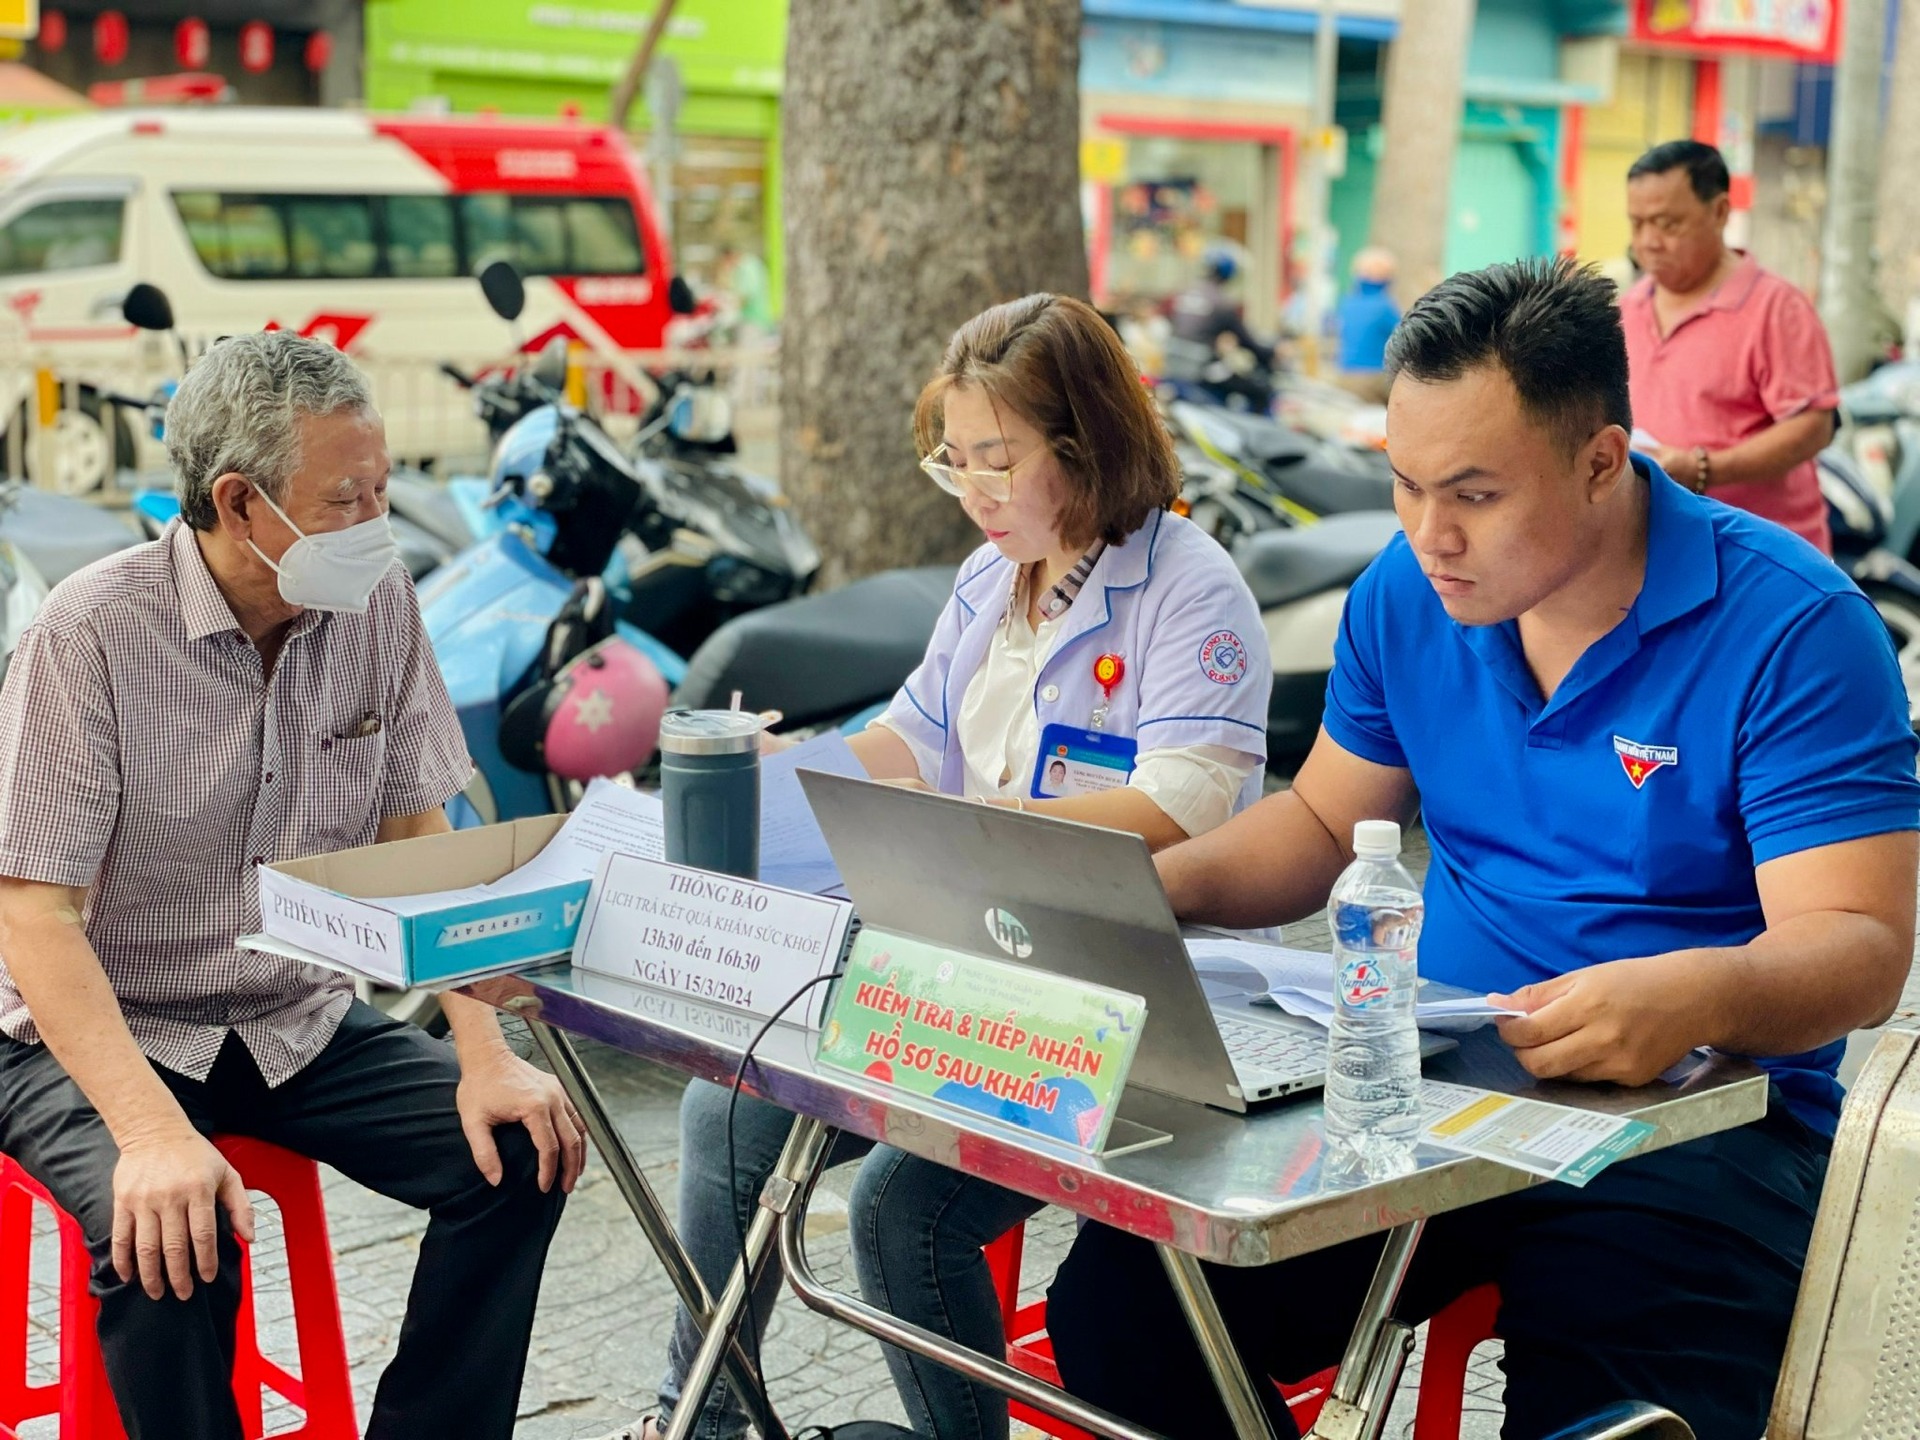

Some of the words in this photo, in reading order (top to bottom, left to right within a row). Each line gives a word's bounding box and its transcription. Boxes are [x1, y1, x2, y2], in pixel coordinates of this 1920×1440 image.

[1203, 635, 1221, 662] TRUNG
[1222, 633, 1240, 647] TÂM
[1208, 669, 1231, 684] QUẬN
[1655, 749, 1675, 760] NAM
[668, 873, 729, 903] THÔNG
[731, 887, 768, 912] BÁO
[325, 912, 348, 939] KÝ
[352, 922, 388, 953] TÊN
[452, 910, 543, 940] EVERYDAY
[605, 889, 633, 907] LỊCH
[635, 896, 658, 915] TRẢ
[660, 902, 685, 920] KẾT
[686, 909, 712, 927] QUẢ
[714, 915, 754, 937] KHÁM
[754, 925, 782, 945] SỨC
[783, 935, 821, 955] KHỎE
[990, 908, 1029, 958] hp
[640, 926, 684, 953] 13h30
[685, 935, 712, 960] đến
[716, 945, 762, 974] 16h30
[632, 958, 681, 988] NGÀY
[684, 972, 753, 1008] 15/3/2024
[1339, 971, 1382, 988] Number
[855, 968, 911, 1019] KIỂM
[914, 999, 955, 1033] TRA
[956, 1013, 972, 1037] &
[976, 1009, 1027, 1052] TIẾP
[1027, 1034, 1103, 1079] NHẬN
[865, 1021, 904, 1059] HỒ
[901, 1042, 936, 1072] SƠ
[934, 1054, 983, 1087] SAU
[983, 1070, 1060, 1114] KHÁM
